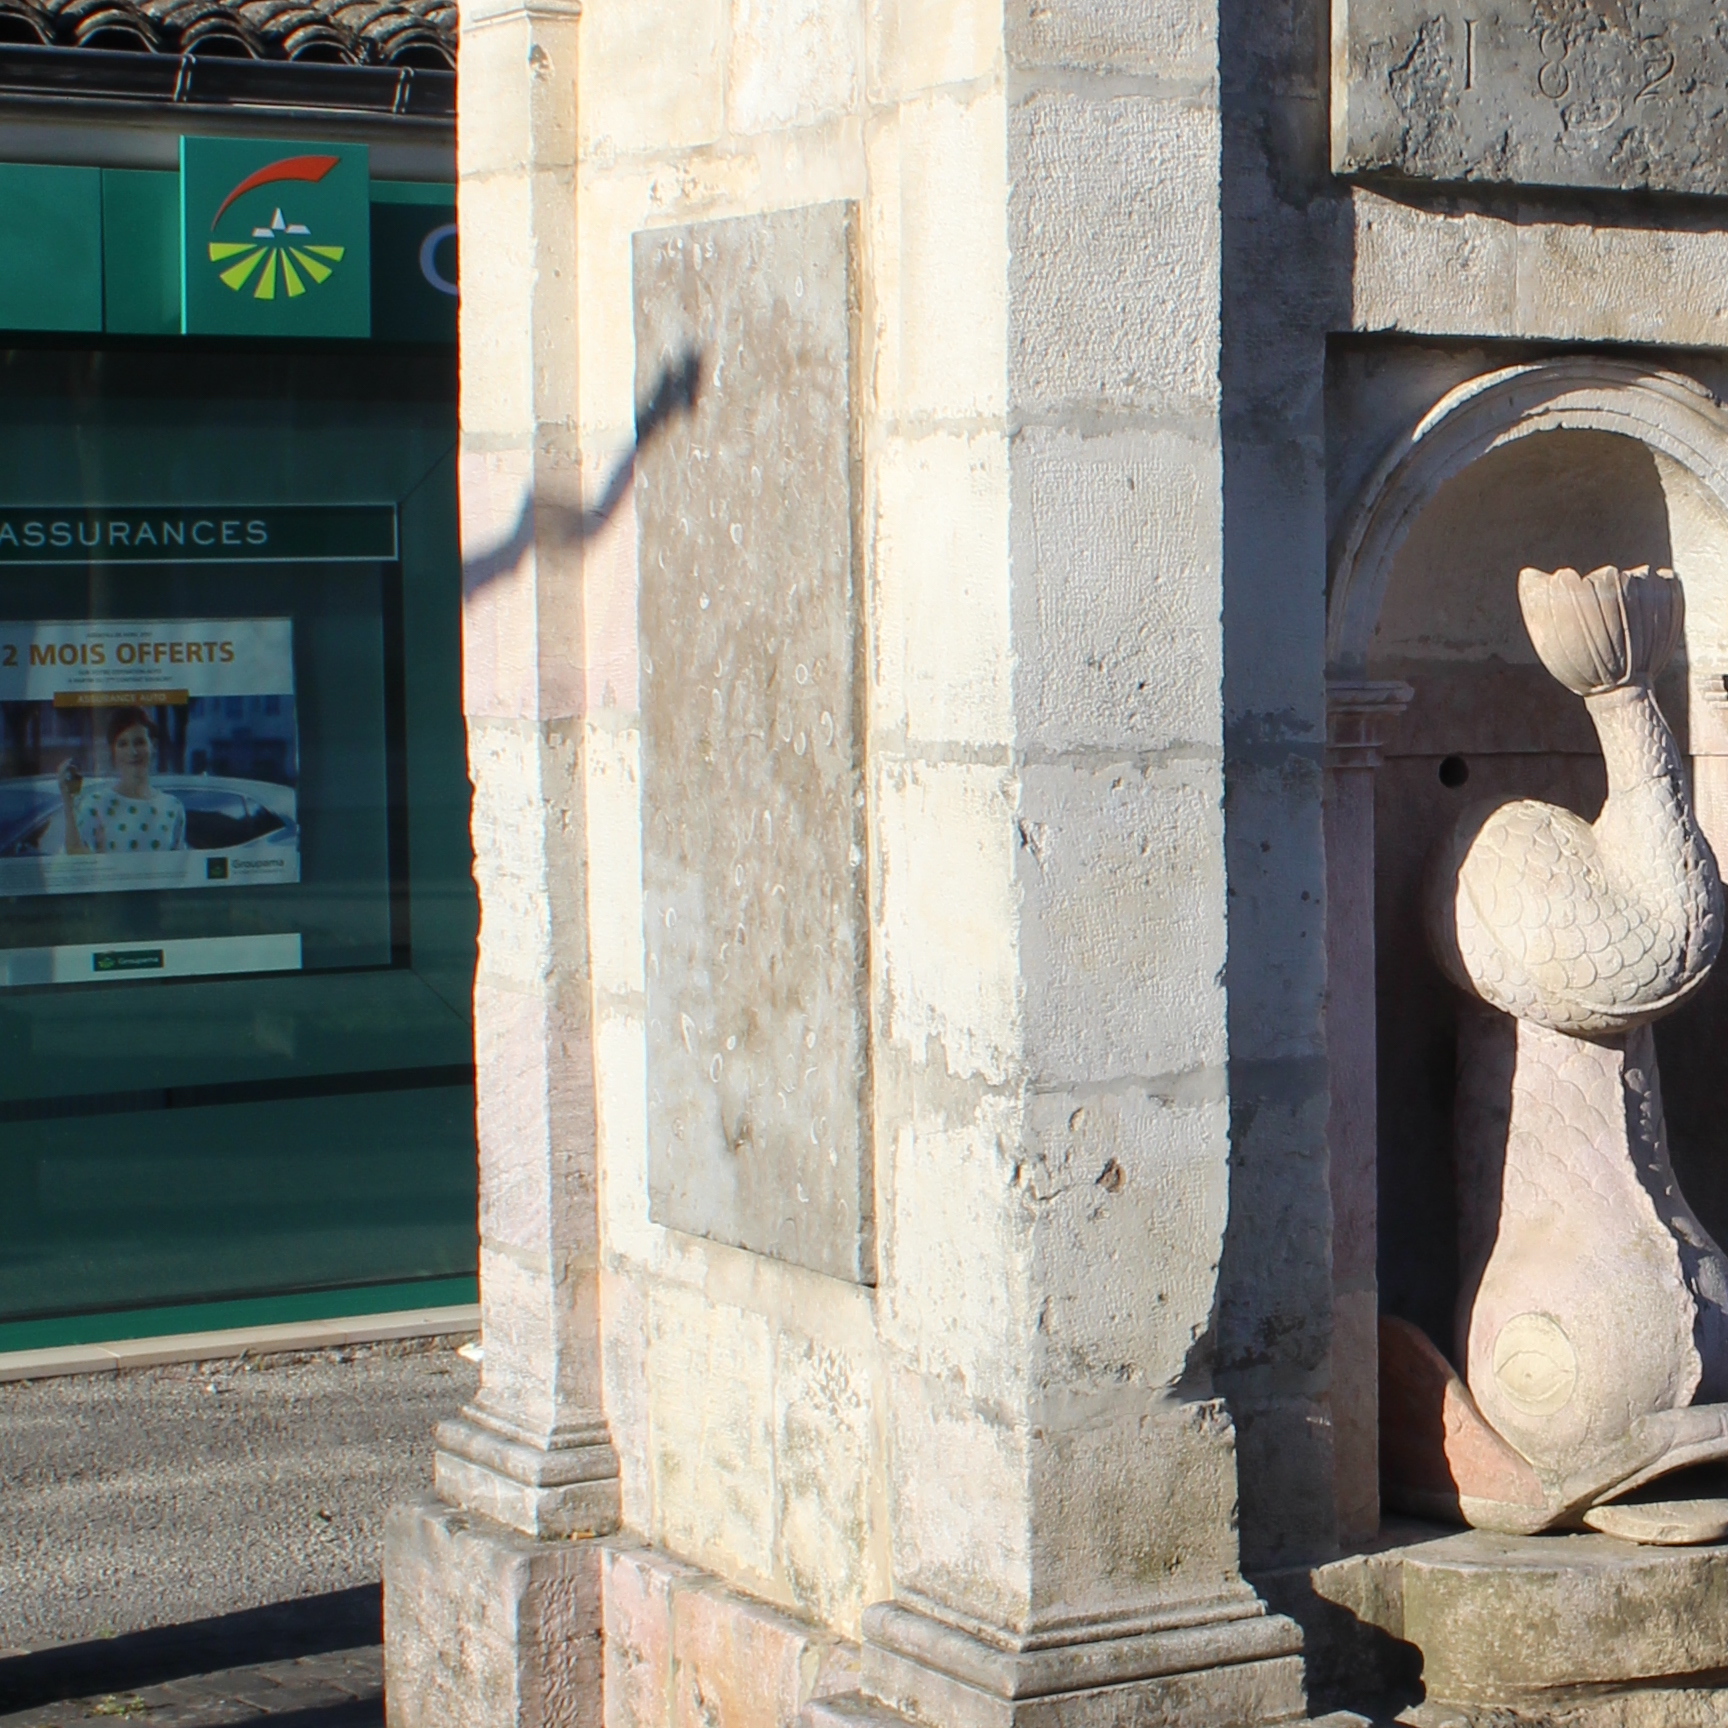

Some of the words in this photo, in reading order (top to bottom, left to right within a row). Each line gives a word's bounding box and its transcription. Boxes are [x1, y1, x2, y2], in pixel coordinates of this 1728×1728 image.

[0, 520, 269, 547] ASSURANCES
[2, 643, 18, 667] 2
[29, 642, 106, 666] MOIS
[116, 640, 235, 665] OFFERTS
